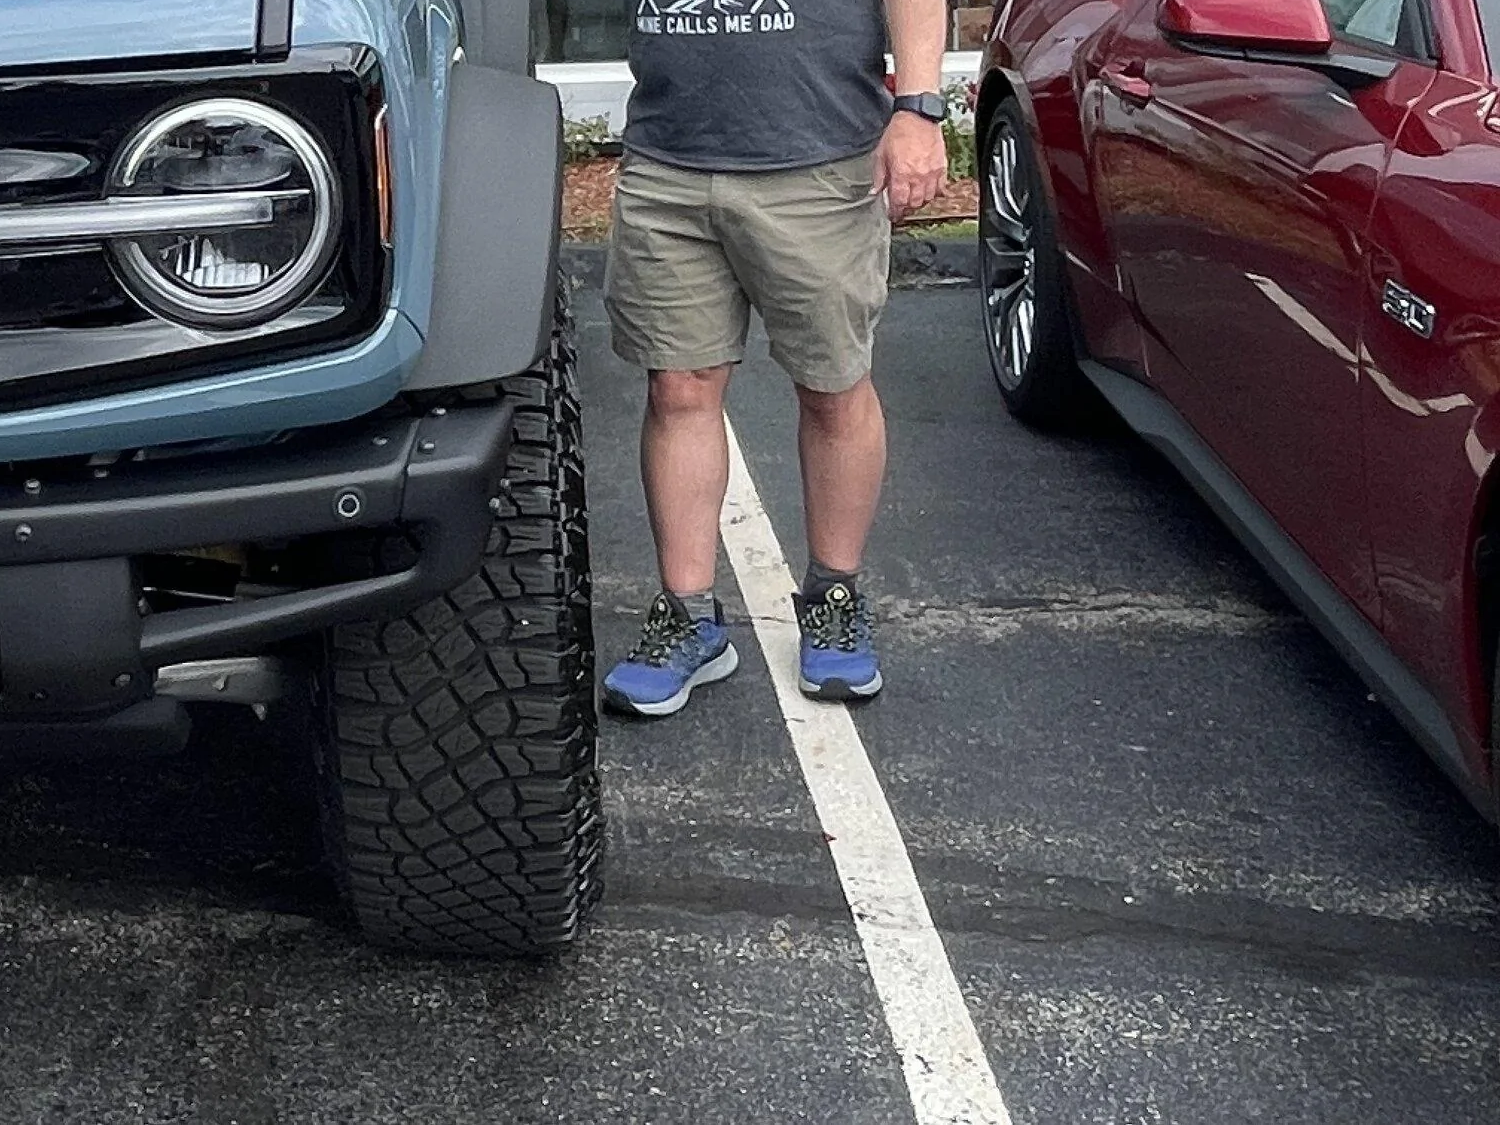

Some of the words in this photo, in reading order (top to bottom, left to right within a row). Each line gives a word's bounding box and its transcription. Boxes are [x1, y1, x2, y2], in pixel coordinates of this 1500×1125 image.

[667, 16, 718, 35] CALLS
[725, 14, 753, 34] ME
[760, 12, 795, 32] DAD
